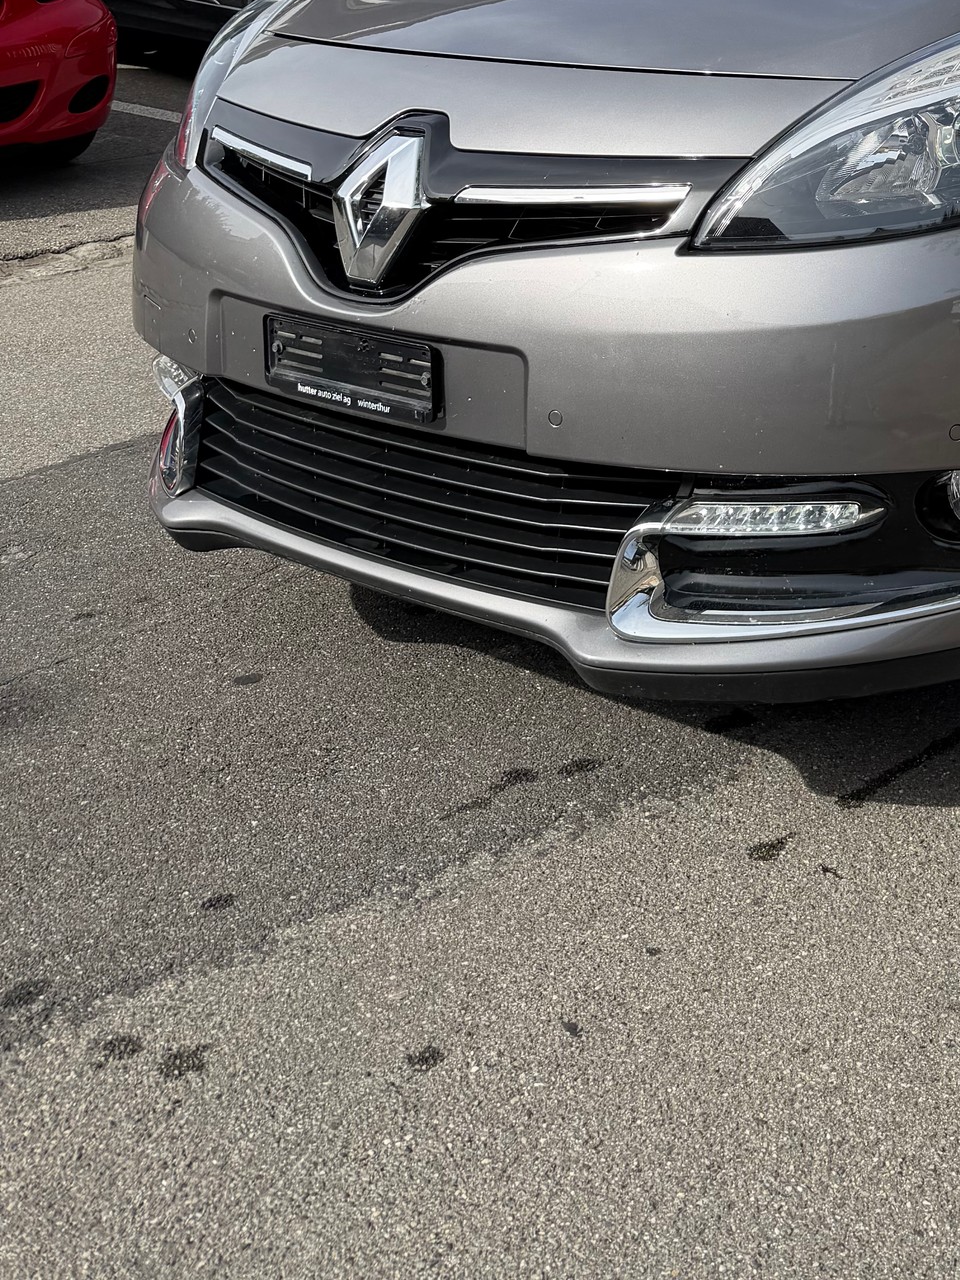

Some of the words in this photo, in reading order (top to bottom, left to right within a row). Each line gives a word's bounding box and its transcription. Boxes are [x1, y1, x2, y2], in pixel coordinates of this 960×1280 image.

[297, 382, 317, 396] hutter
[317, 389, 332, 399] auto
[331, 392, 343, 402] ziel
[343, 396, 352, 406] ag
[357, 399, 391, 413] winterthur
